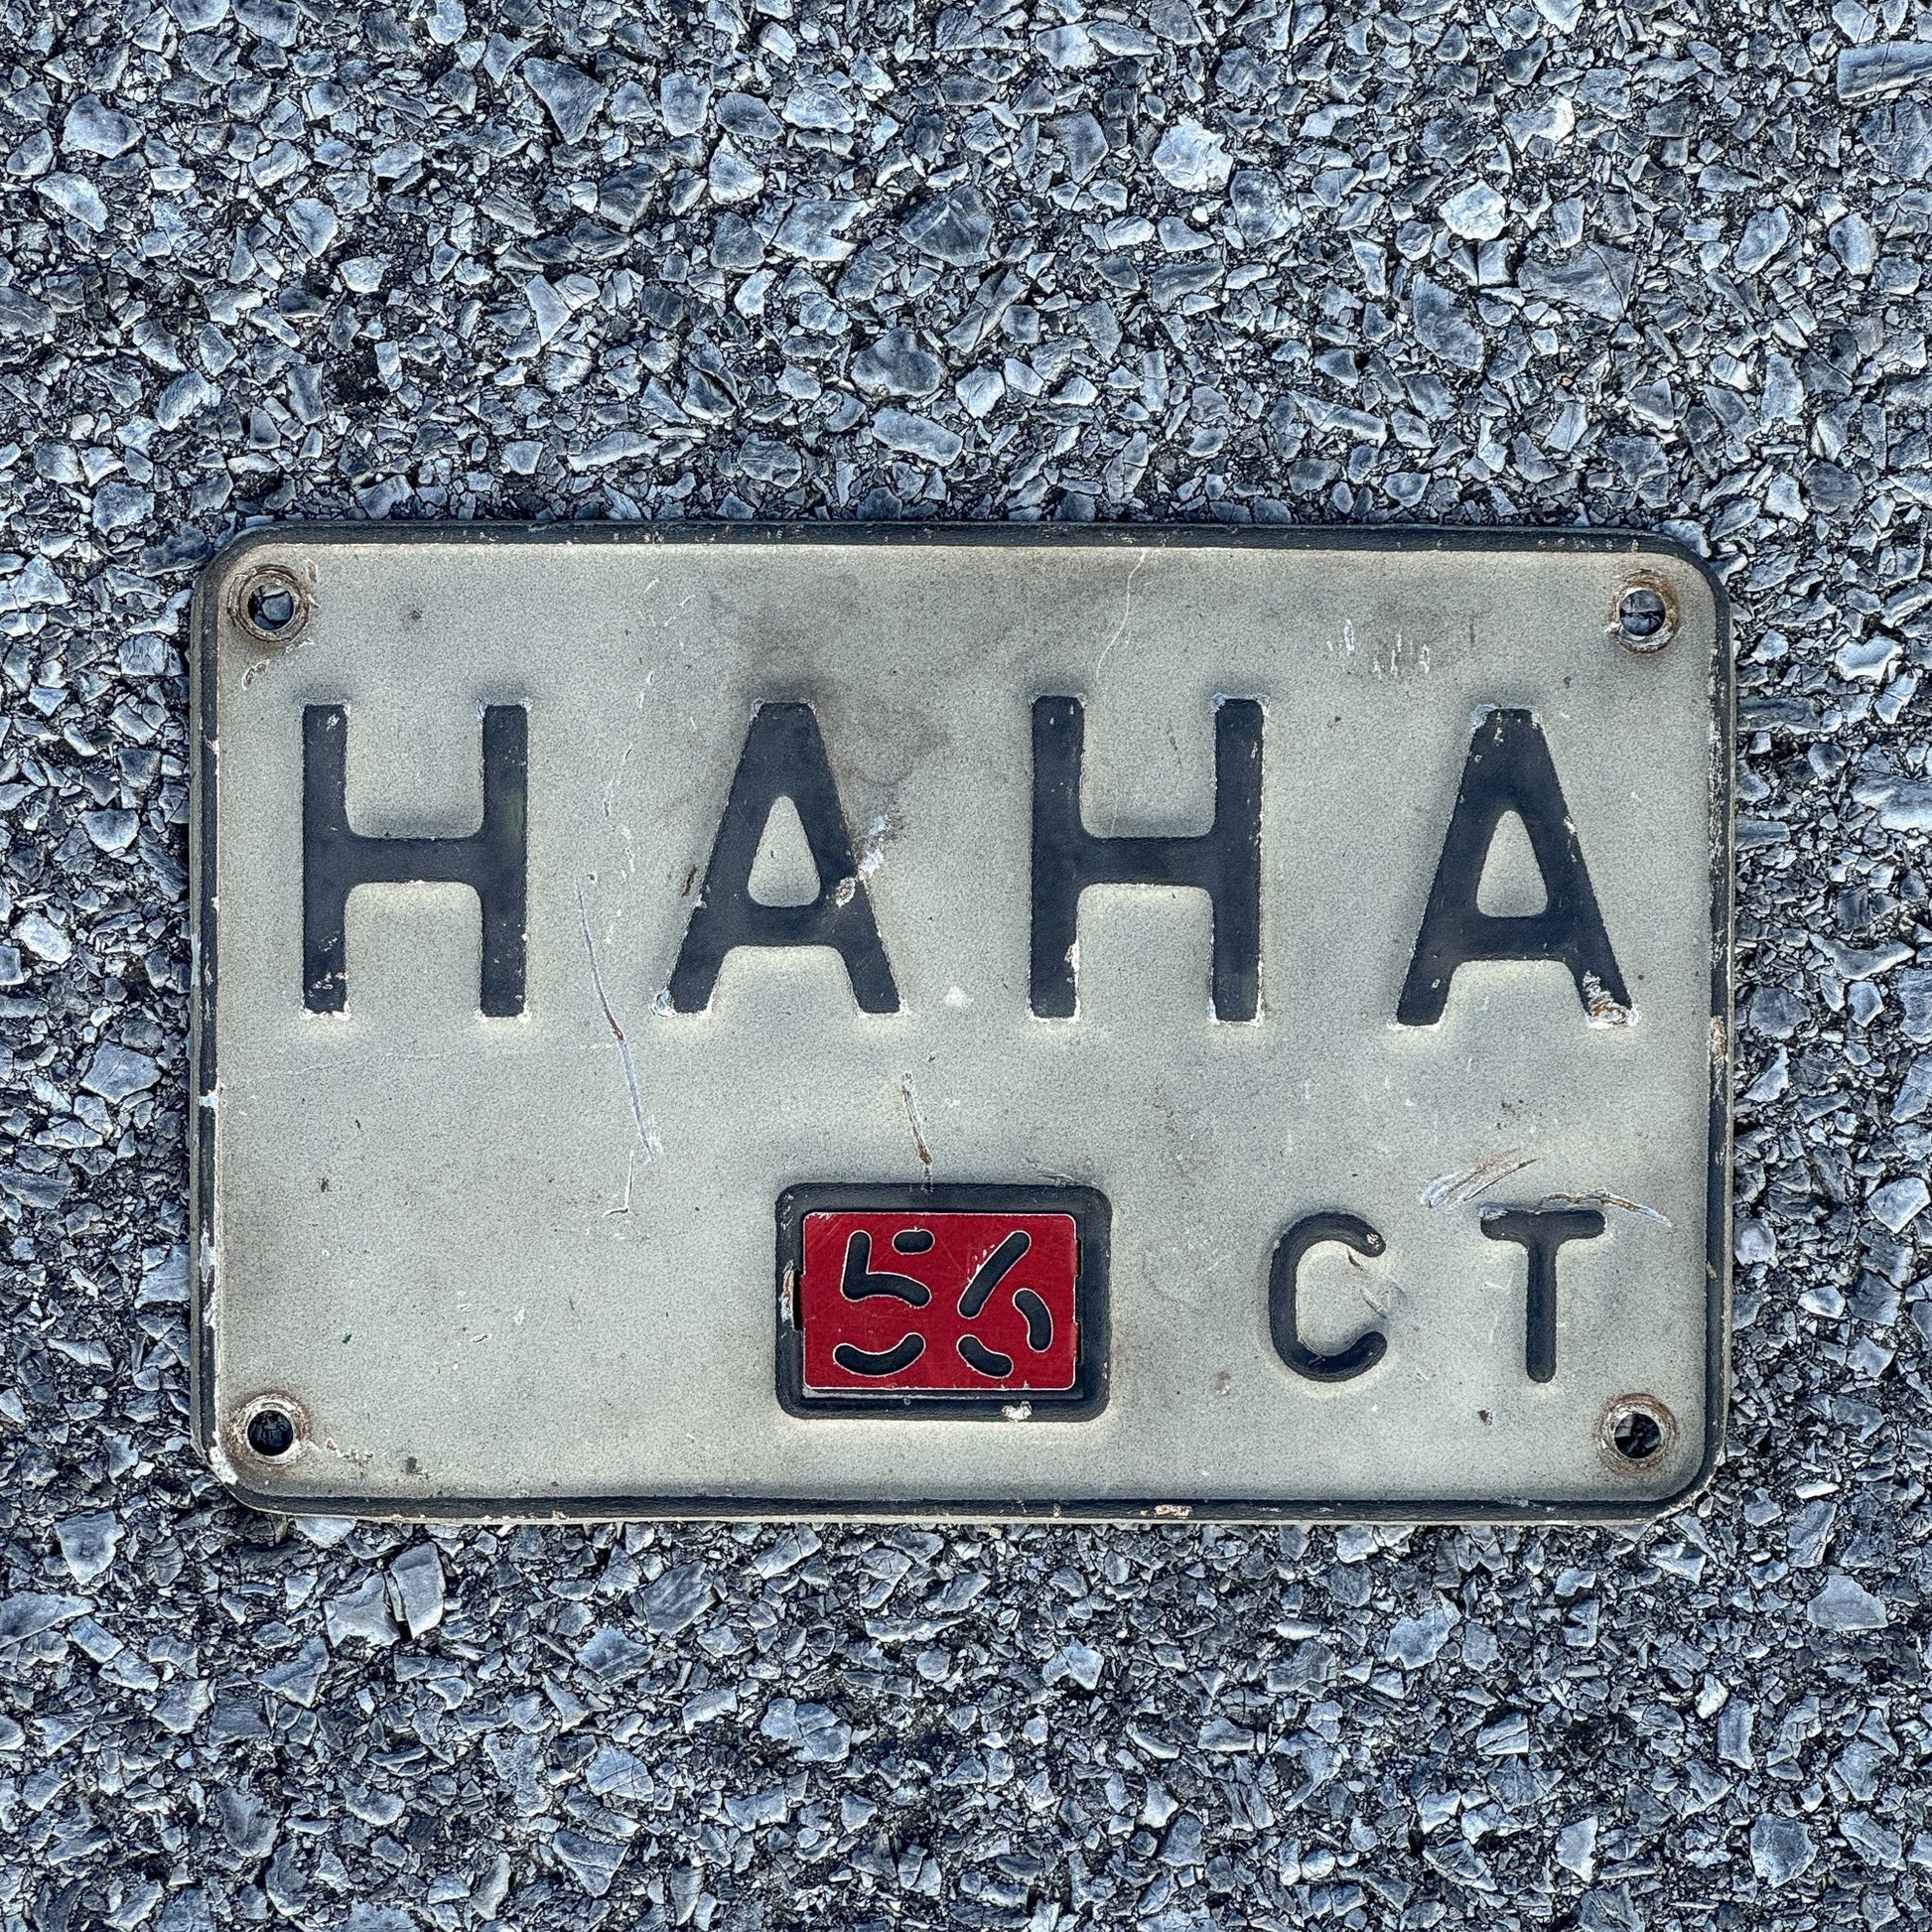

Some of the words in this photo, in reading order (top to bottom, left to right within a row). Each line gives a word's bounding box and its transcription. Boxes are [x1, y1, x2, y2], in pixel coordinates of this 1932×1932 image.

[301, 695, 1632, 1028] HAHA
[833, 1229, 1053, 1378] 56
[1269, 1208, 1607, 1383] CT
